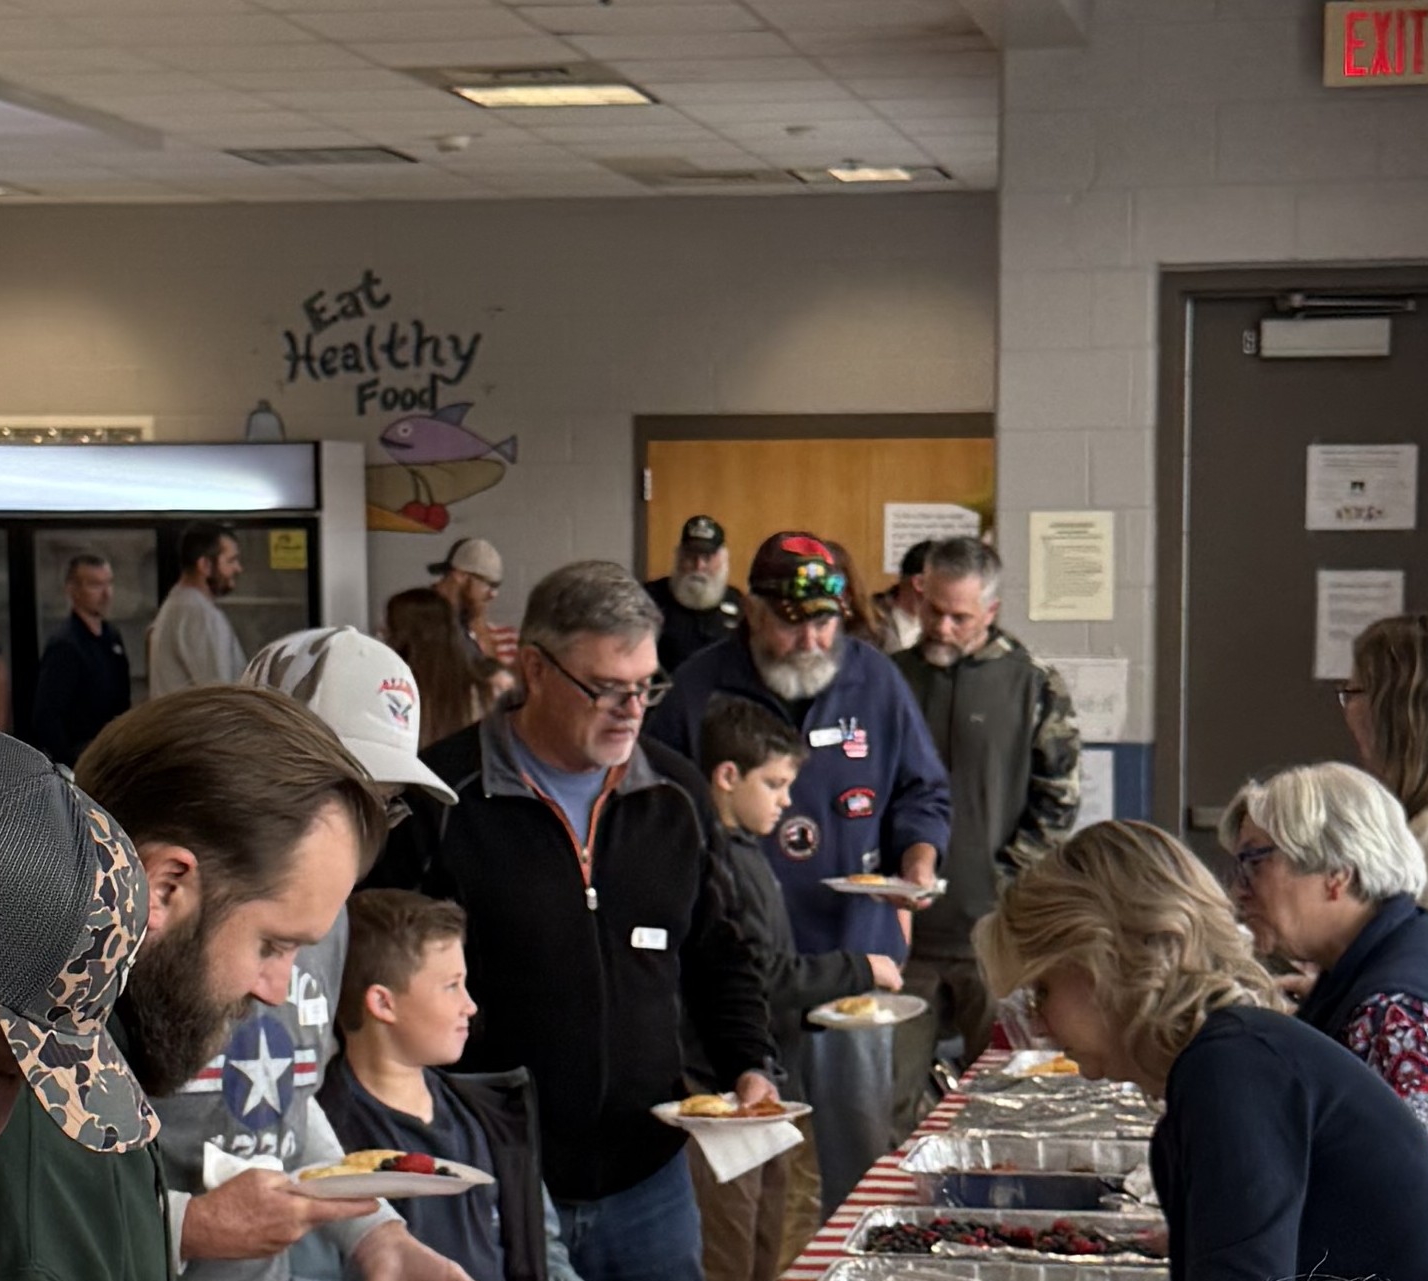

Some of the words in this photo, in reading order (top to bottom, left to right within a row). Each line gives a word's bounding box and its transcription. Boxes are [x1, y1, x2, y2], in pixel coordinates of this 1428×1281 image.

[303, 269, 391, 334] Eat
[284, 318, 481, 385] Healthy
[357, 374, 437, 416] Food
